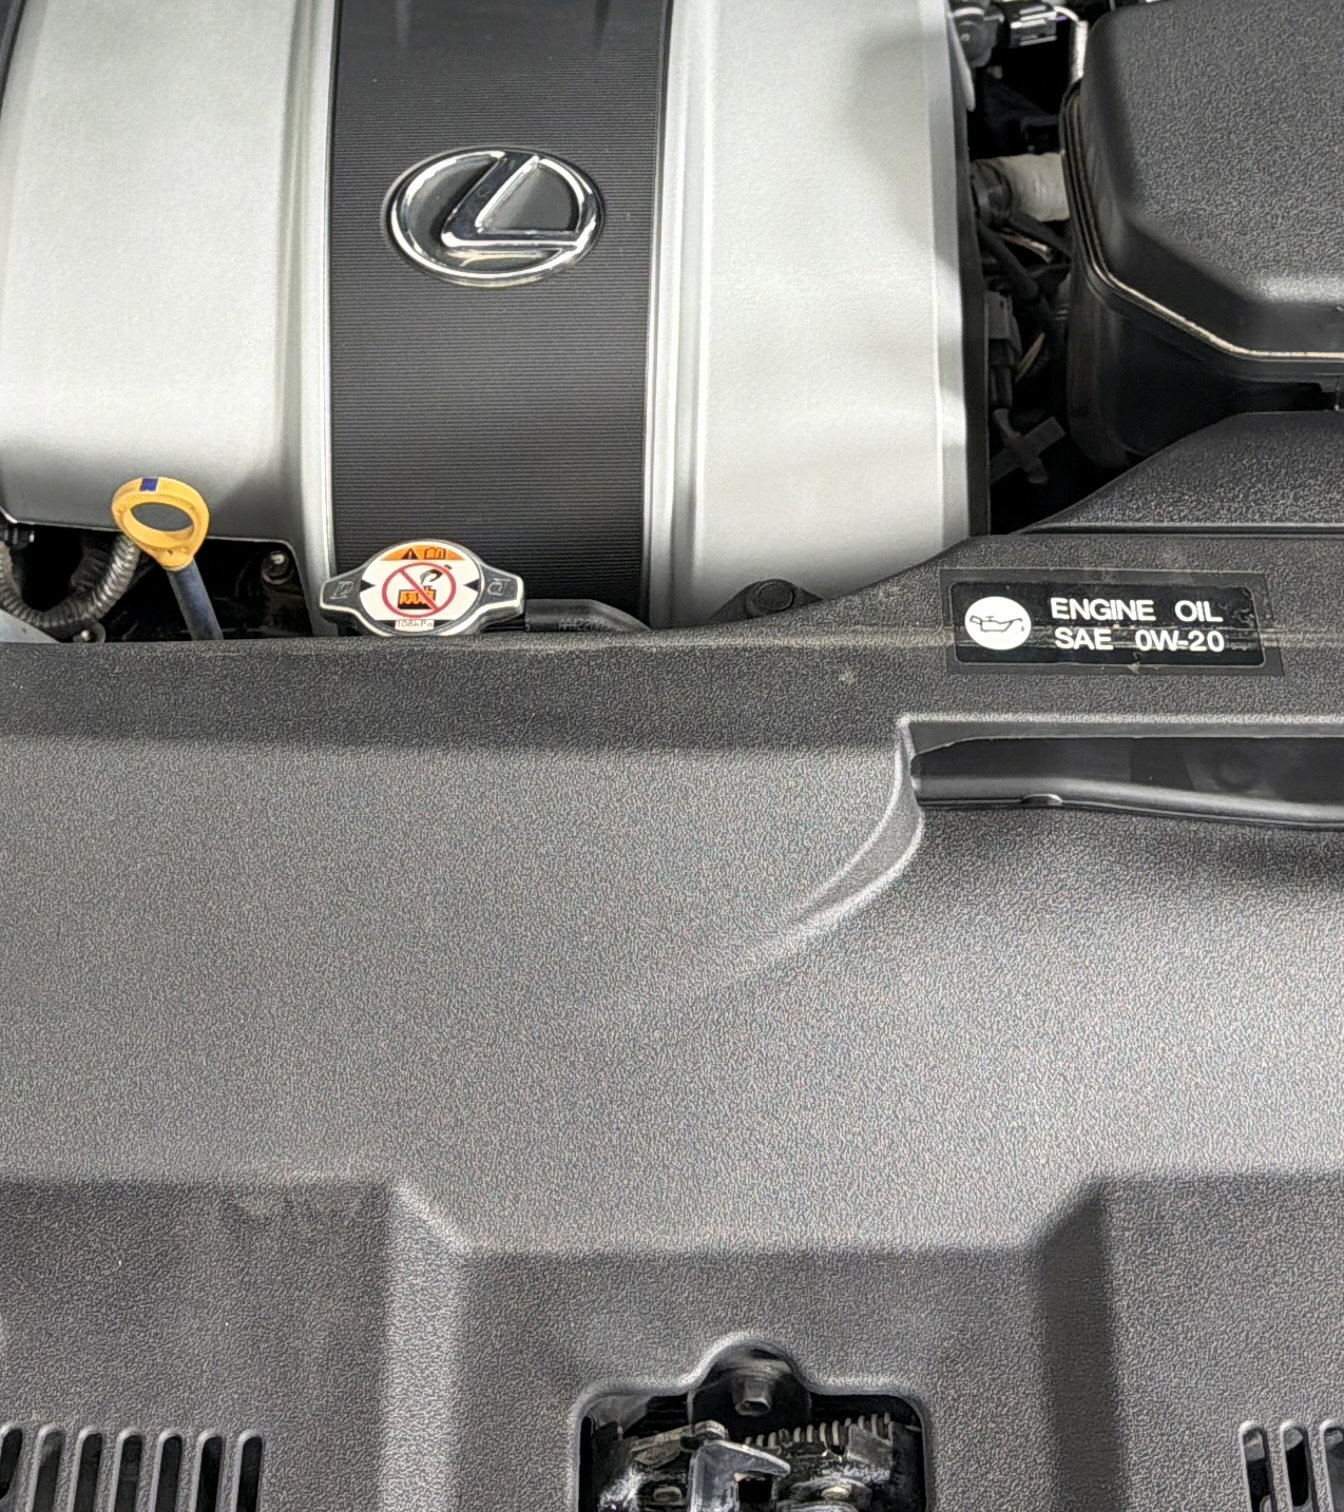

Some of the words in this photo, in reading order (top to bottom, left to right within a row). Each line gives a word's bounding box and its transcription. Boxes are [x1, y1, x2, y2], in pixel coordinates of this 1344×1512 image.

[1050, 597, 1156, 622] ENGINE
[1174, 599, 1224, 623] OIL
[1054, 628, 1114, 651] SAE
[1135, 630, 1225, 653] 0W-20
